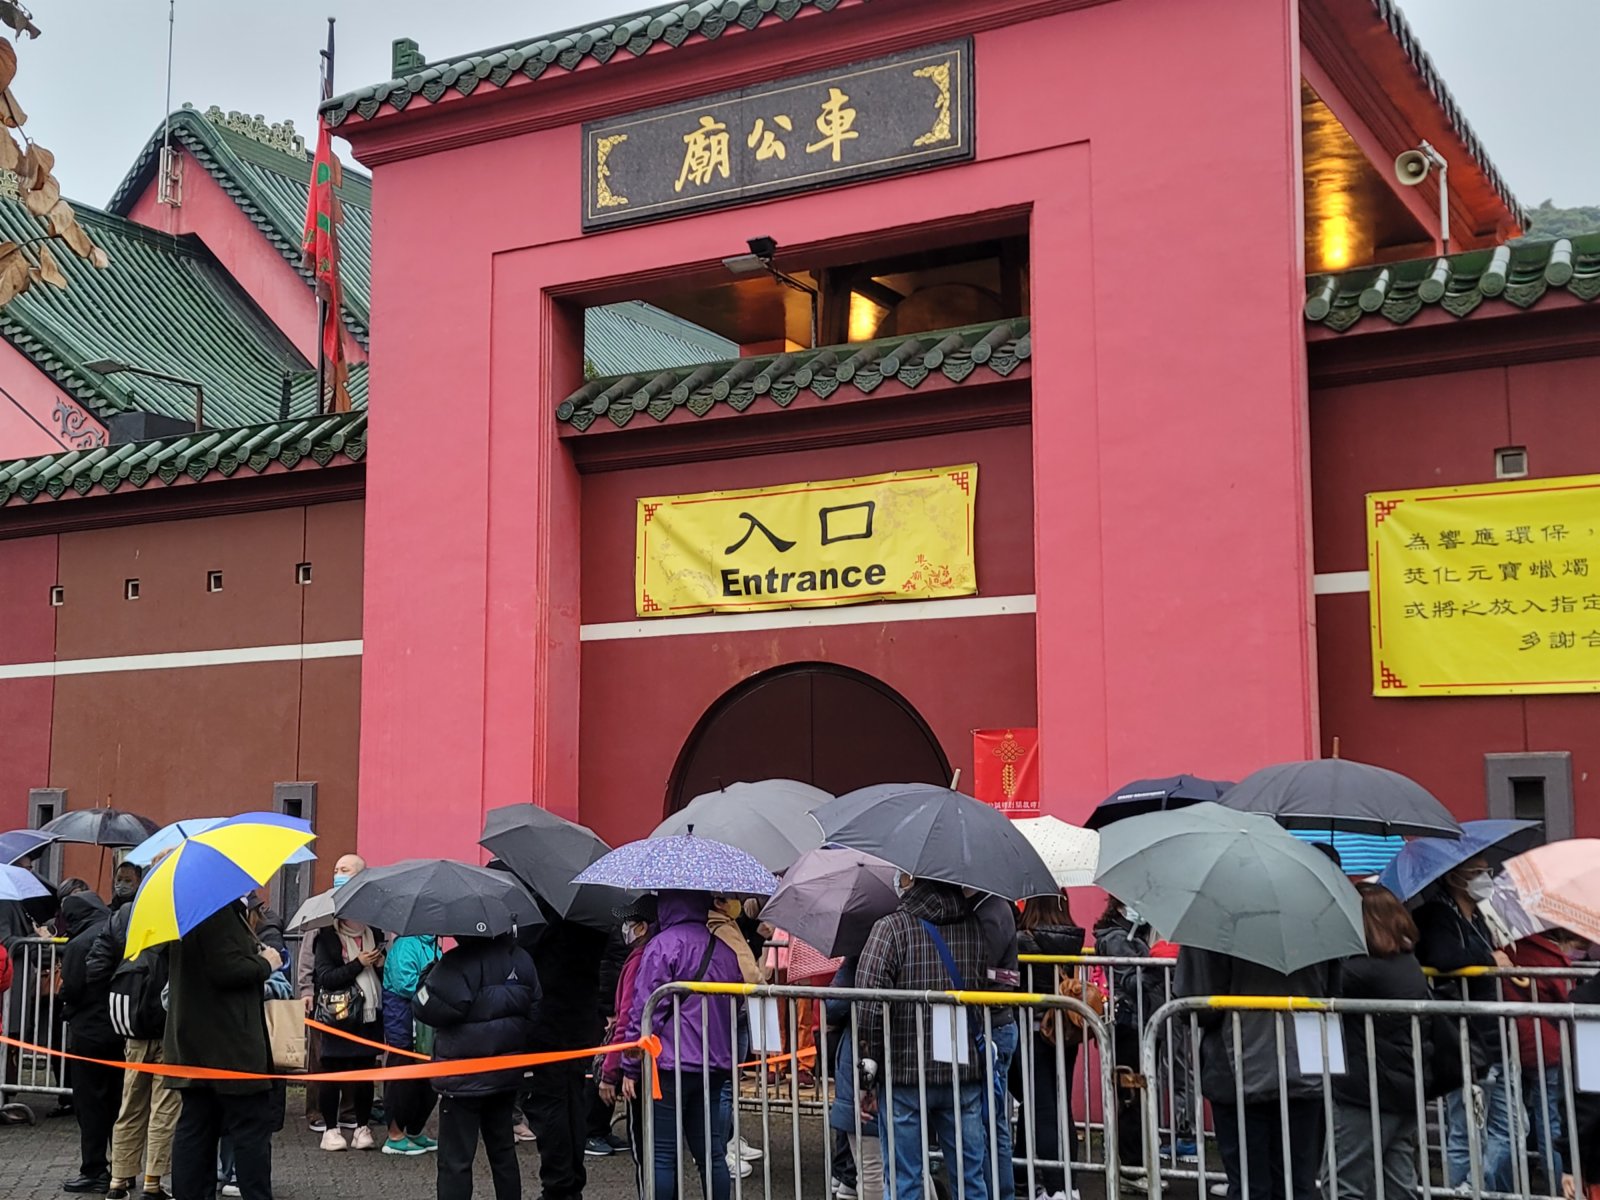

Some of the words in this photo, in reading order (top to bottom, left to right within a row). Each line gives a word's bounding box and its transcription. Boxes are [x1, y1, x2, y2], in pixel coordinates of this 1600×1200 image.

[674, 88, 859, 192] 車公廟
[725, 501, 875, 555] 入口
[721, 564, 886, 597] Entrance
